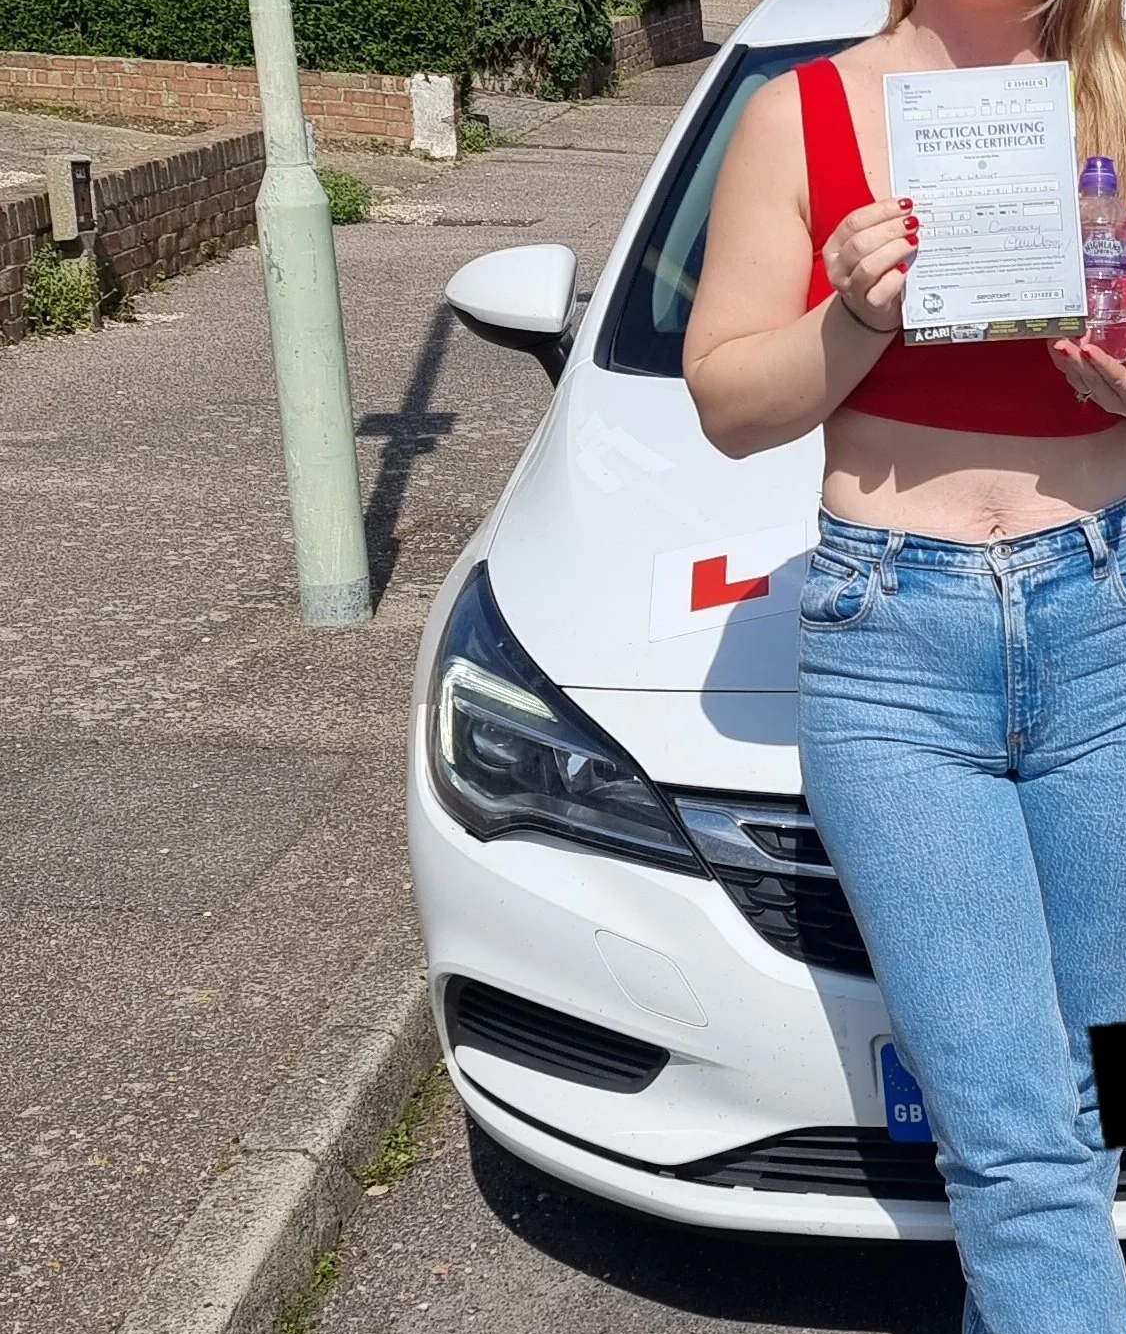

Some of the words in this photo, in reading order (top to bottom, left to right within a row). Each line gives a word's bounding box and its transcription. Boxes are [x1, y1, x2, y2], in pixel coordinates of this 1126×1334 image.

[915, 125, 985, 142] PRACTICAL
[987, 120, 1045, 137] DRIVING
[915, 141, 942, 153] TEST
[945, 138, 972, 151] PASS
[975, 134, 1046, 150] CERTIFICATE
[915, 331, 924, 342] A
[690, 554, 770, 612] L
[894, 1103, 923, 1123] GB
